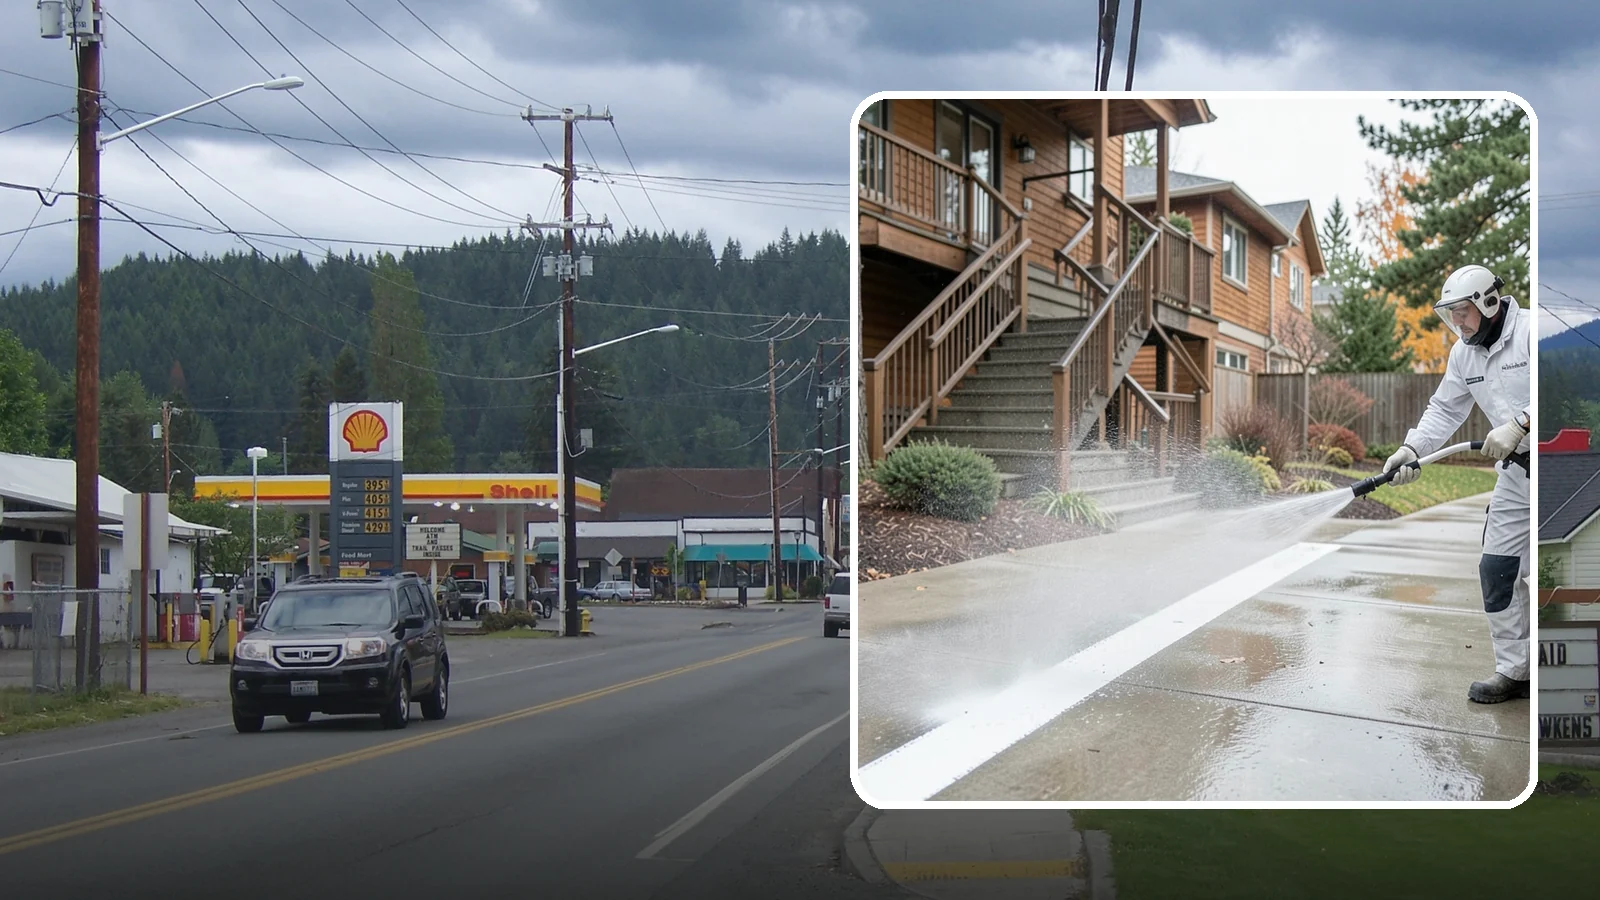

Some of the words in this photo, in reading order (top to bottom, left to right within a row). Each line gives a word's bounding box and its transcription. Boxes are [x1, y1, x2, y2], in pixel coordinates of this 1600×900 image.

[366, 480, 383, 490] 395
[490, 484, 547, 499] Shell
[365, 494, 383, 504] 405
[365, 508, 383, 518] 415
[366, 522, 383, 532] 429
